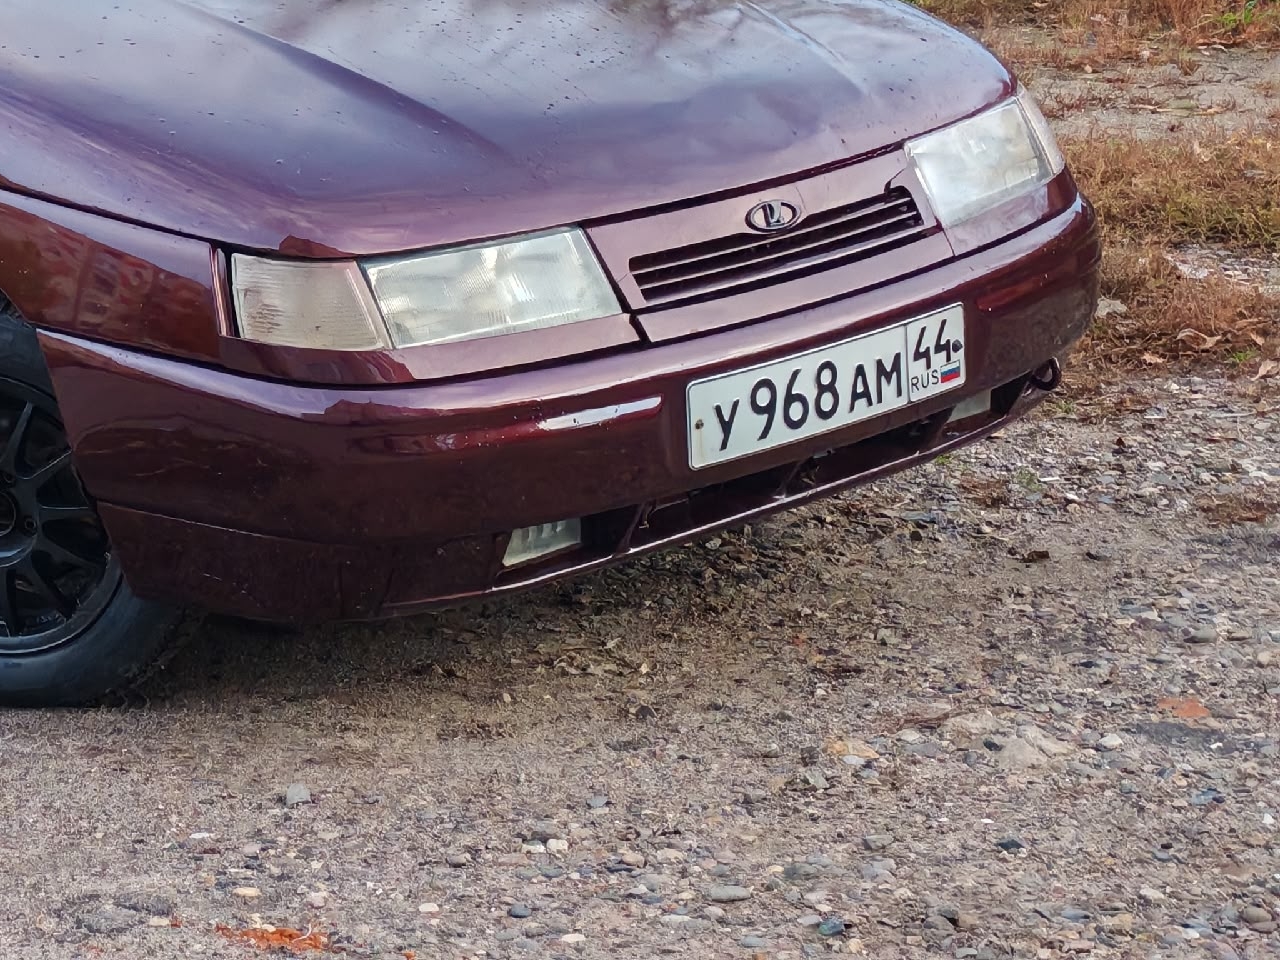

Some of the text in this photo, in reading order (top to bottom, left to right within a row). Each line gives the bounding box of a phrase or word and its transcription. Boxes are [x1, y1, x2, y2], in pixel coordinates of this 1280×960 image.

[714, 319, 953, 451] У968АМ 44
[911, 371, 940, 394] RUS
